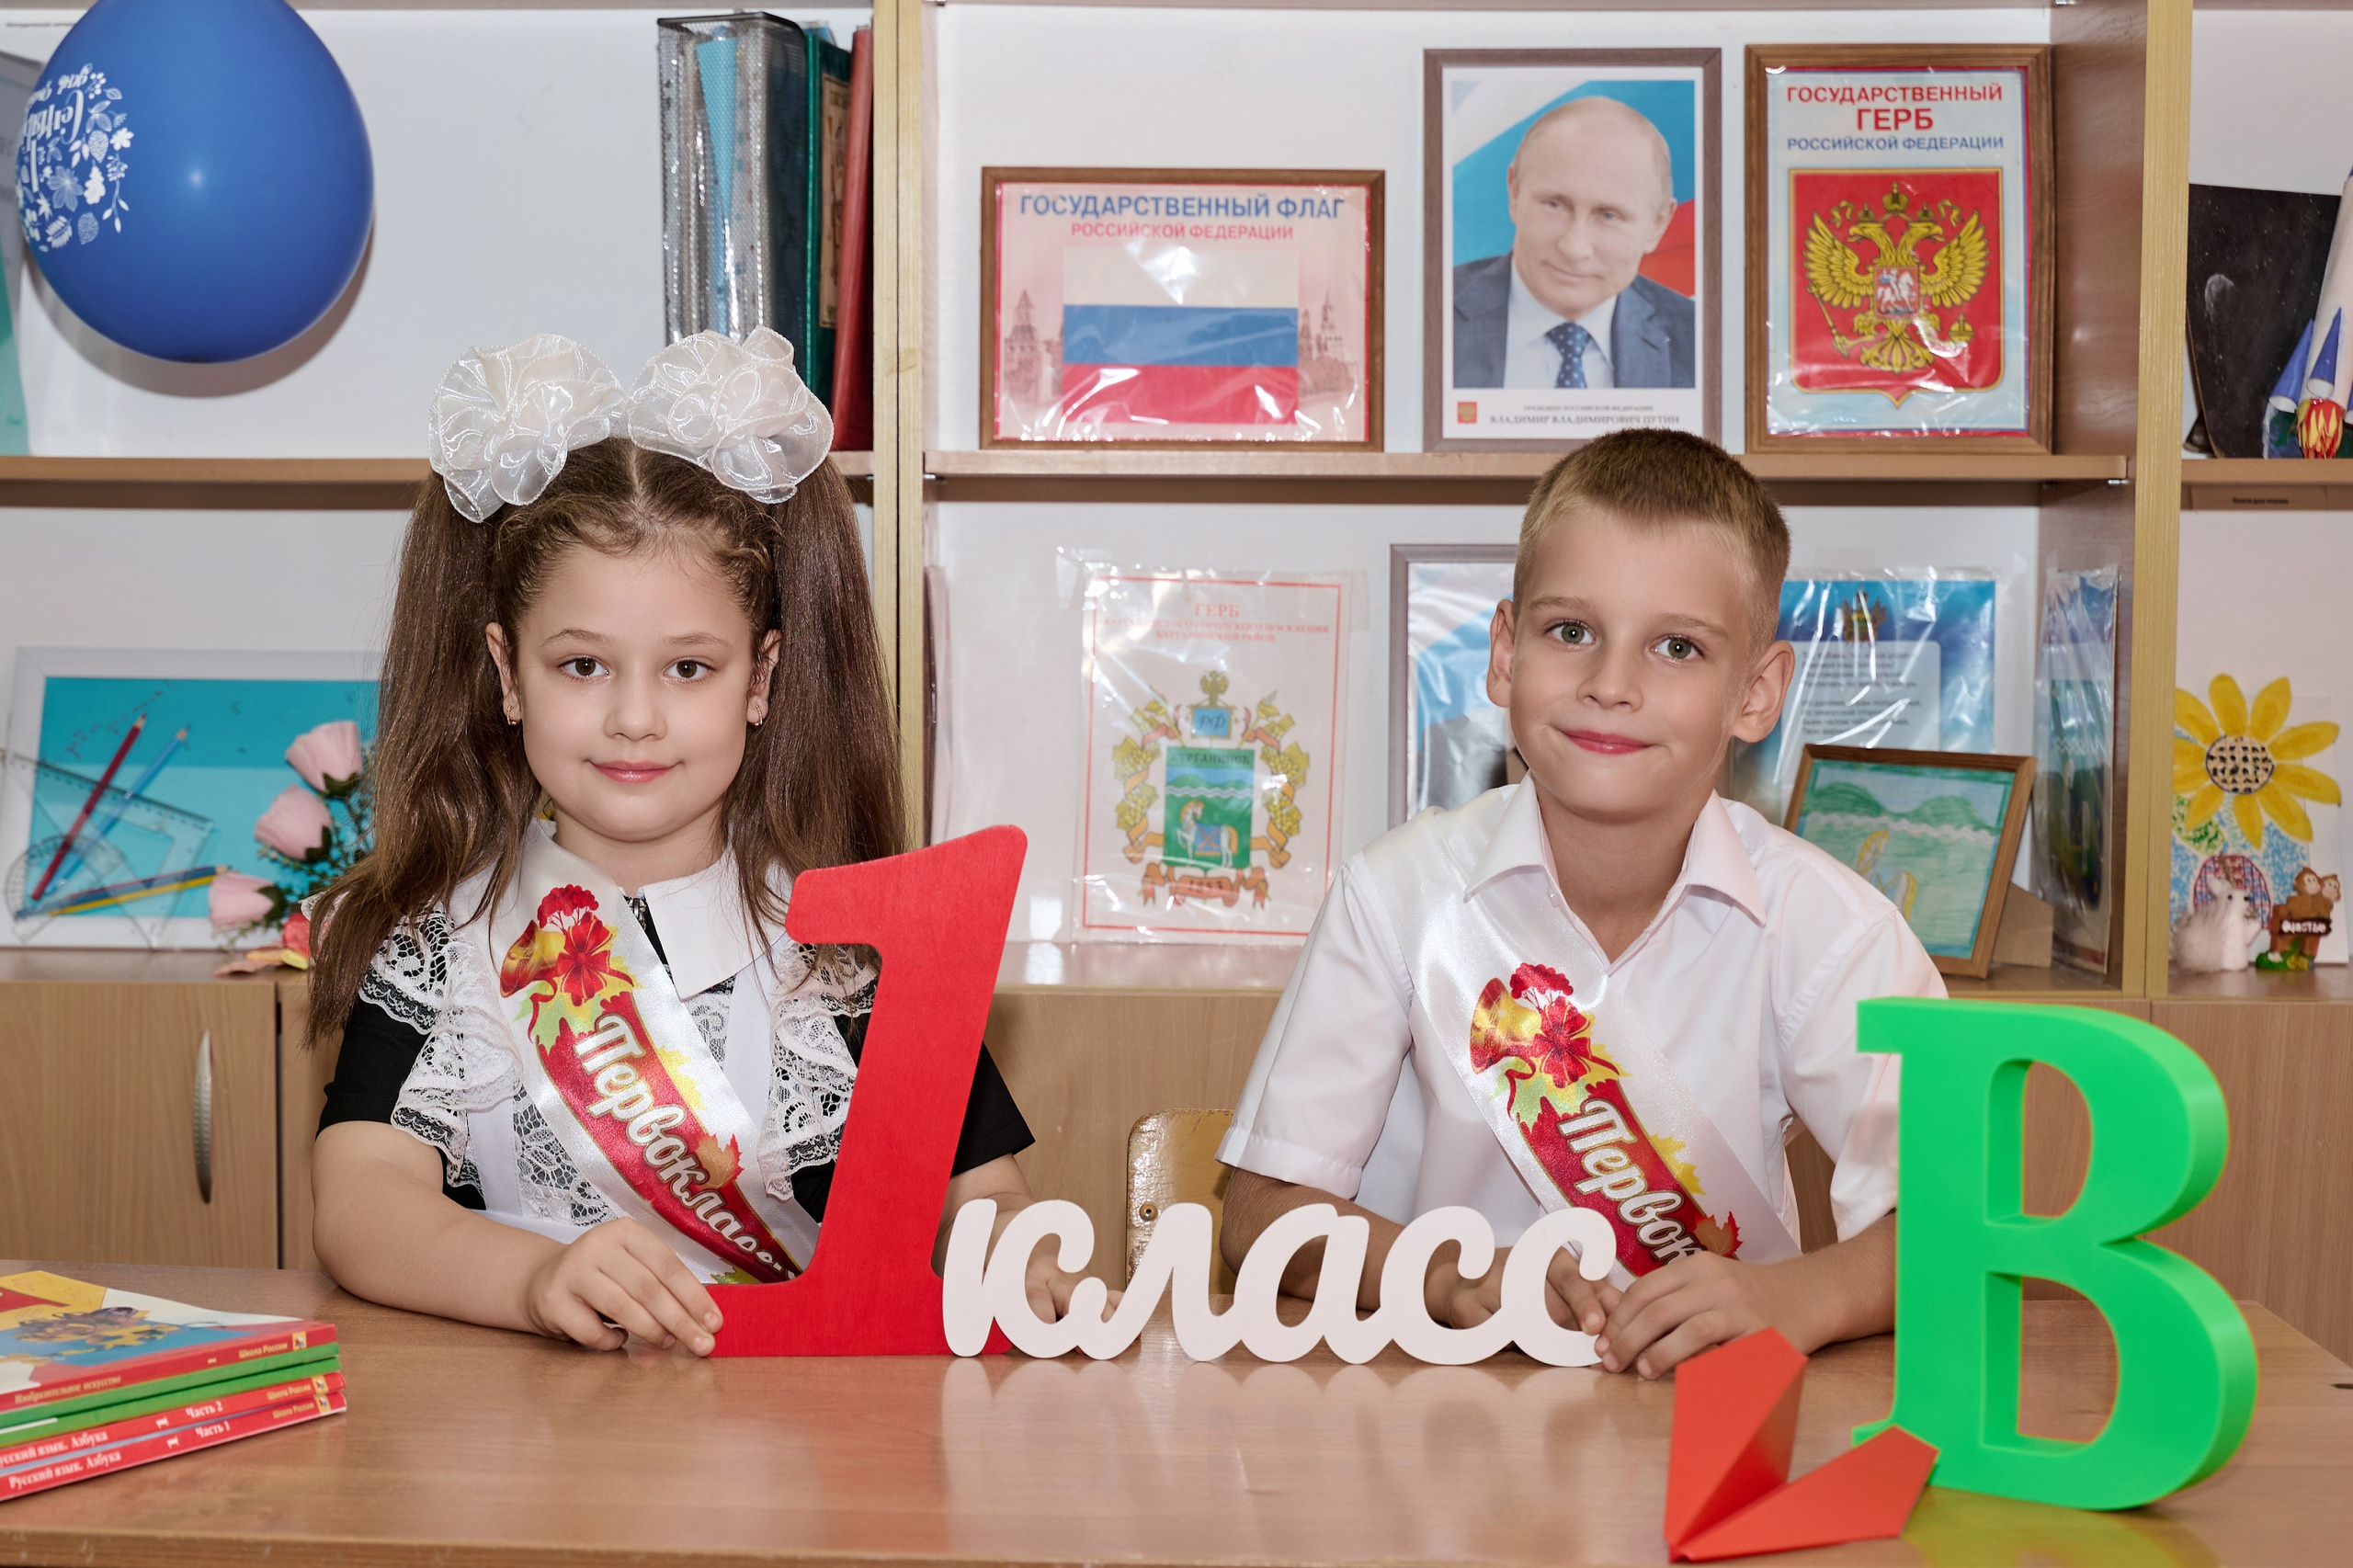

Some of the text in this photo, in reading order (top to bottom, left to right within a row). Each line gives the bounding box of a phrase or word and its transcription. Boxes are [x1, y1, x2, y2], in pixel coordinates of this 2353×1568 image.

[1788, 82, 2003, 104] ГОСУДАРСТВЕННЫЙ
[1857, 108, 1934, 131] ГЕРБ
[1787, 136, 2005, 152] РОССИЙСКОЙ ФЕДЕРАЦИИ
[1020, 192, 1346, 219] ГОСУДАРСТВЕННЫЙ ФЛАГ
[1071, 222, 1294, 241] РОССИЙСКОЙ ФЕДЕРАЦИИ
[1490, 415, 1680, 425] ВЛАДИМИР ВЛАДИМИРОВИЧ ПУТИН
[1195, 604, 1240, 619] ГЕРБ
[710, 824, 1618, 1368] 1 класс
[238, 1342, 289, 1359] Школа России
[15, 1376, 122, 1405] Изобразительное искусство
[267, 1383, 312, 1401] Школа России
[186, 1400, 224, 1419] Часть 2
[272, 1402, 315, 1419] Школа России
[195, 1420, 231, 1438] Часть 1
[0, 1430, 108, 1468] усский язык. Азбука
[8, 1451, 122, 1490] Русский язык. Азбука
